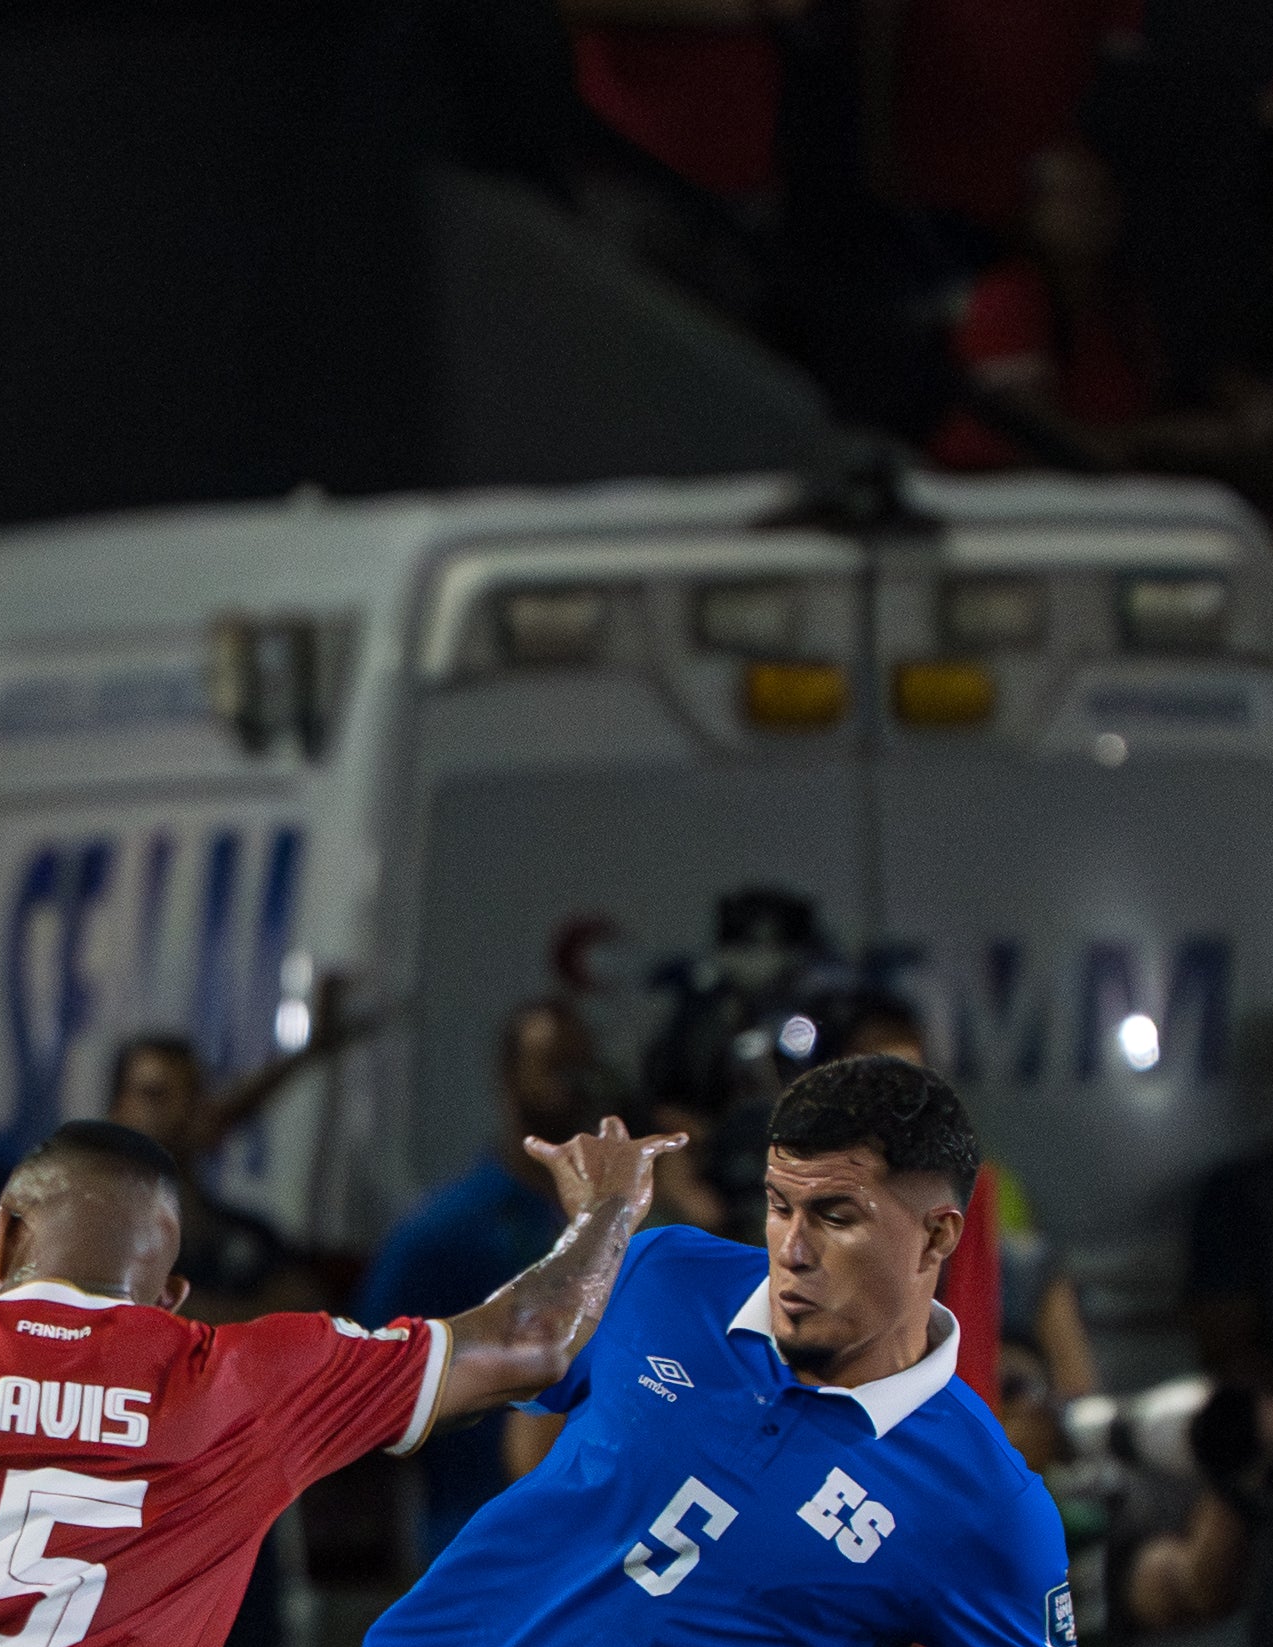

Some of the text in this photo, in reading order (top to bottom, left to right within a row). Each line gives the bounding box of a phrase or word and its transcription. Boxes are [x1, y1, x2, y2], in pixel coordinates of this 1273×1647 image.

[16, 1320, 92, 1341] PANAMA
[637, 1374, 678, 1403] umbro
[624, 1476, 738, 1596] 5
[796, 1466, 896, 1563] ES
